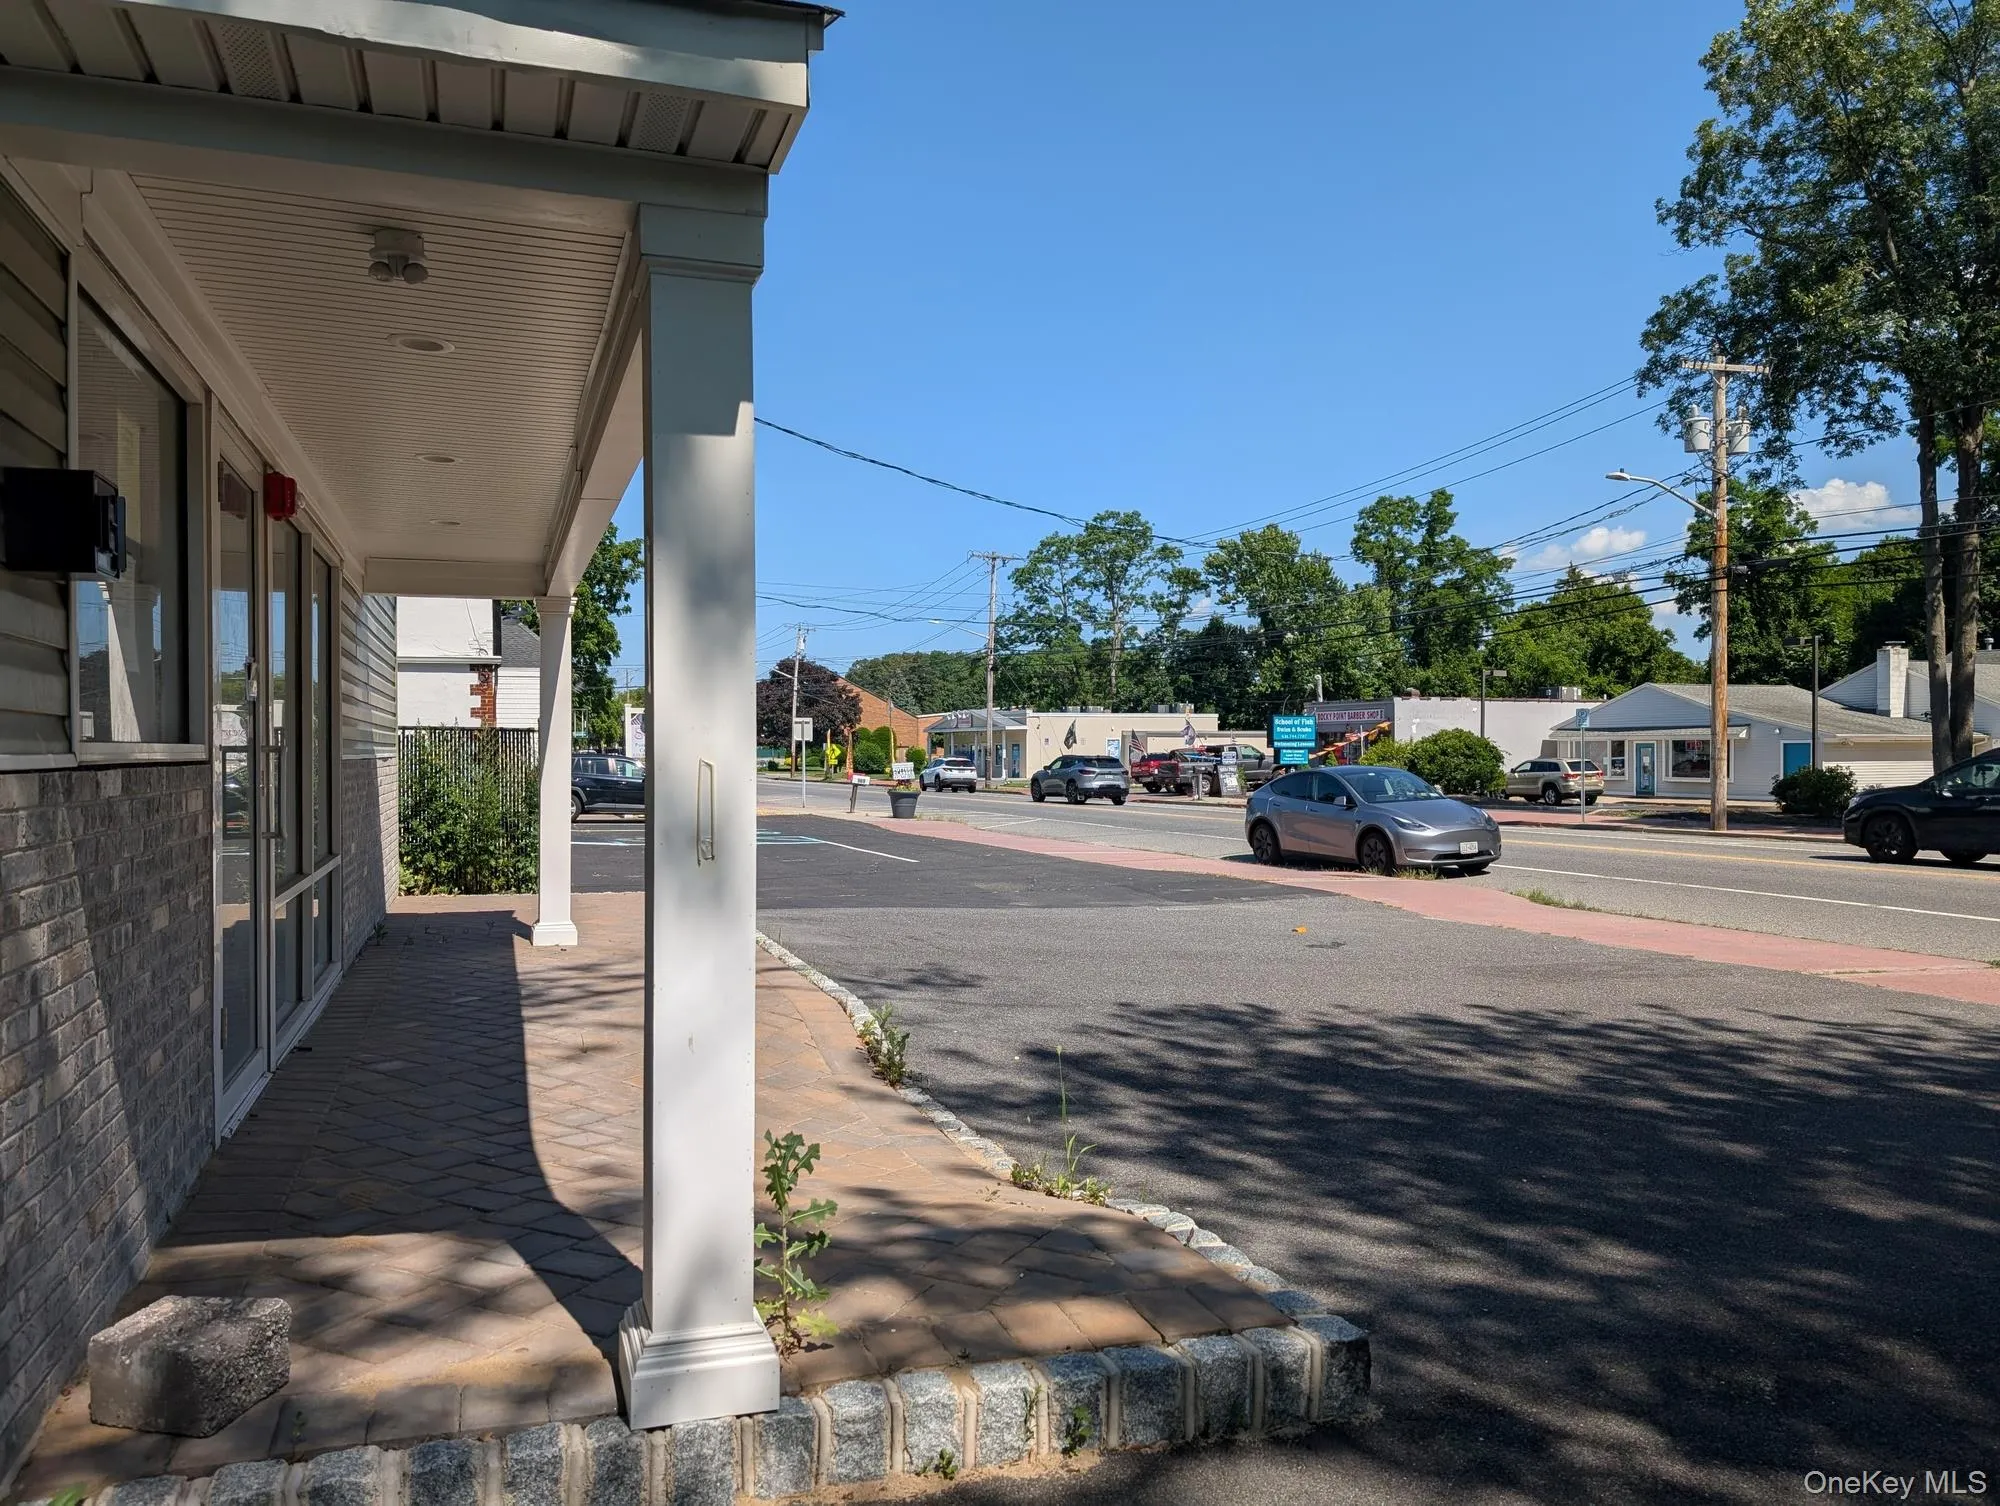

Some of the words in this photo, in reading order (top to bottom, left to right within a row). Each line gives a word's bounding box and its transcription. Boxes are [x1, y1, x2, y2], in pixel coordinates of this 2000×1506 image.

[1333, 712, 1346, 720] POINT
[1348, 711, 1366, 720] BARBER
[1367, 710, 1379, 719] SHOP
